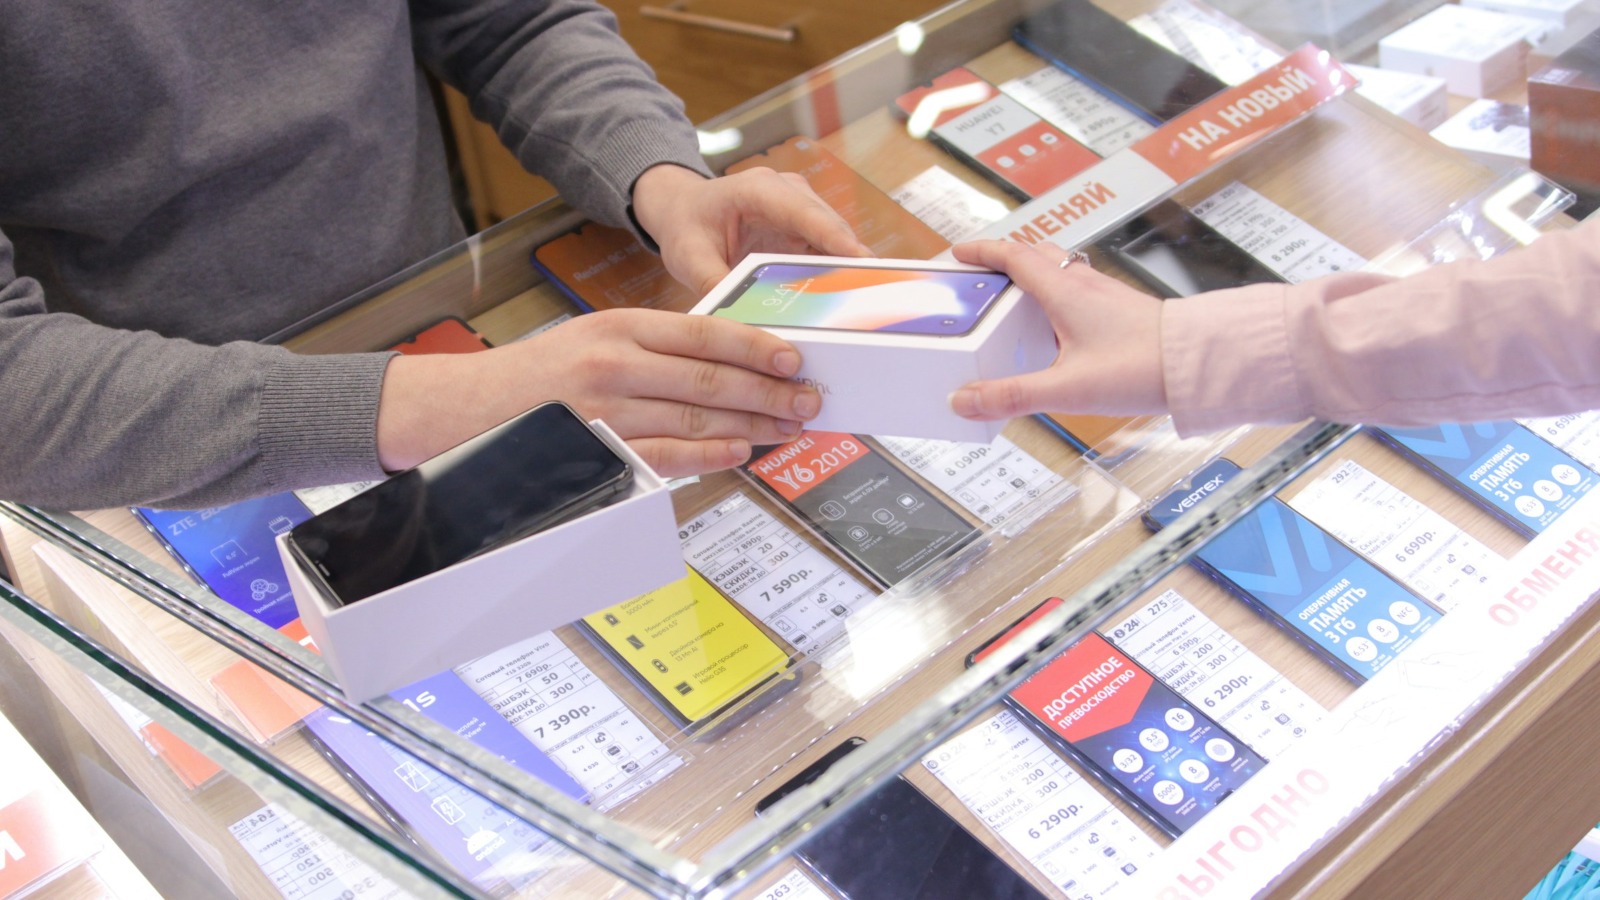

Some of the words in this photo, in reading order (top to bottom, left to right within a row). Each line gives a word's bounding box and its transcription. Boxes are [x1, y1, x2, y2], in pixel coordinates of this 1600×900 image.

[954, 104, 1004, 133] HUAWEI
[1178, 120, 1229, 151] НА
[1218, 66, 1318, 125] НОВЫЙ
[984, 118, 1007, 138] Y7
[999, 180, 1118, 249] МЕНЯЙ
[1547, 427, 1558, 436] 6
[758, 436, 816, 475] HUAWEI
[773, 463, 815, 491] Y6
[810, 439, 859, 475] 2019
[944, 467, 956, 477] 8
[953, 446, 992, 470] 090р.
[1469, 444, 1515, 481] ОПЕРАТИВНАЯ
[1478, 452, 1531, 492] ПАМЯТЬ
[1332, 469, 1350, 484] 292
[1170, 475, 1224, 513] VERTEX
[1495, 490, 1510, 502] 3
[168, 515, 197, 537] ZTE
[740, 535, 765, 551] 890р.
[1395, 553, 1407, 563] 6
[1404, 531, 1437, 555] 690р.
[713, 558, 750, 583] КЭШБЭК
[757, 542, 774, 555] 20
[723, 566, 758, 590] СКИДКА
[768, 550, 789, 567] 300
[1488, 521, 1600, 627] ОБМЕНЯ
[759, 591, 771, 602] 7
[771, 569, 813, 595] 590р.
[1299, 578, 1351, 621] ОПЕРАТИВНАЯ
[1147, 600, 1168, 616] 275
[1308, 587, 1367, 633] ПАМЯТЬ
[1396, 606, 1414, 620] NFC
[669, 640, 695, 657] Двойная
[694, 626, 717, 642] камера
[1155, 626, 1179, 644] телефон
[1177, 614, 1197, 628] Vertex
[1178, 636, 1201, 652] 590р.
[1324, 630, 1341, 644] 3
[475, 664, 506, 684] Сотовый
[505, 650, 535, 668] телефон
[534, 642, 550, 652] Vivo
[524, 663, 552, 680] 690р.
[692, 661, 718, 679] Игровой
[717, 643, 749, 663] процессор
[1160, 660, 1189, 682] ЭШБЭК
[1192, 643, 1214, 659] 200
[1170, 669, 1198, 690] КИДКА
[1206, 654, 1228, 670] 300
[493, 688, 530, 711] ЭШБЭК
[541, 671, 559, 686] 50
[502, 698, 538, 720] КИДКА
[549, 682, 574, 700] 300
[1042, 656, 1124, 721] ДОСТУПНОЕ
[1057, 669, 1136, 730] ПРЕВОСХОДСТВО
[1204, 697, 1216, 708] 6
[1213, 674, 1253, 700] 290р.
[509, 709, 534, 726] ADE-IN
[533, 726, 545, 739] 7
[548, 704, 596, 731] 390р.
[1171, 712, 1185, 723] 16
[1021, 768, 1045, 786] 200
[1119, 754, 1138, 769] 3/32
[1035, 780, 1058, 798] 300
[1157, 784, 1176, 799] 5000
[1028, 827, 1041, 839] 6
[1039, 803, 1084, 831] 290р.
[1155, 768, 1330, 900] ВЫГОДНО
[475, 836, 506, 862] android
